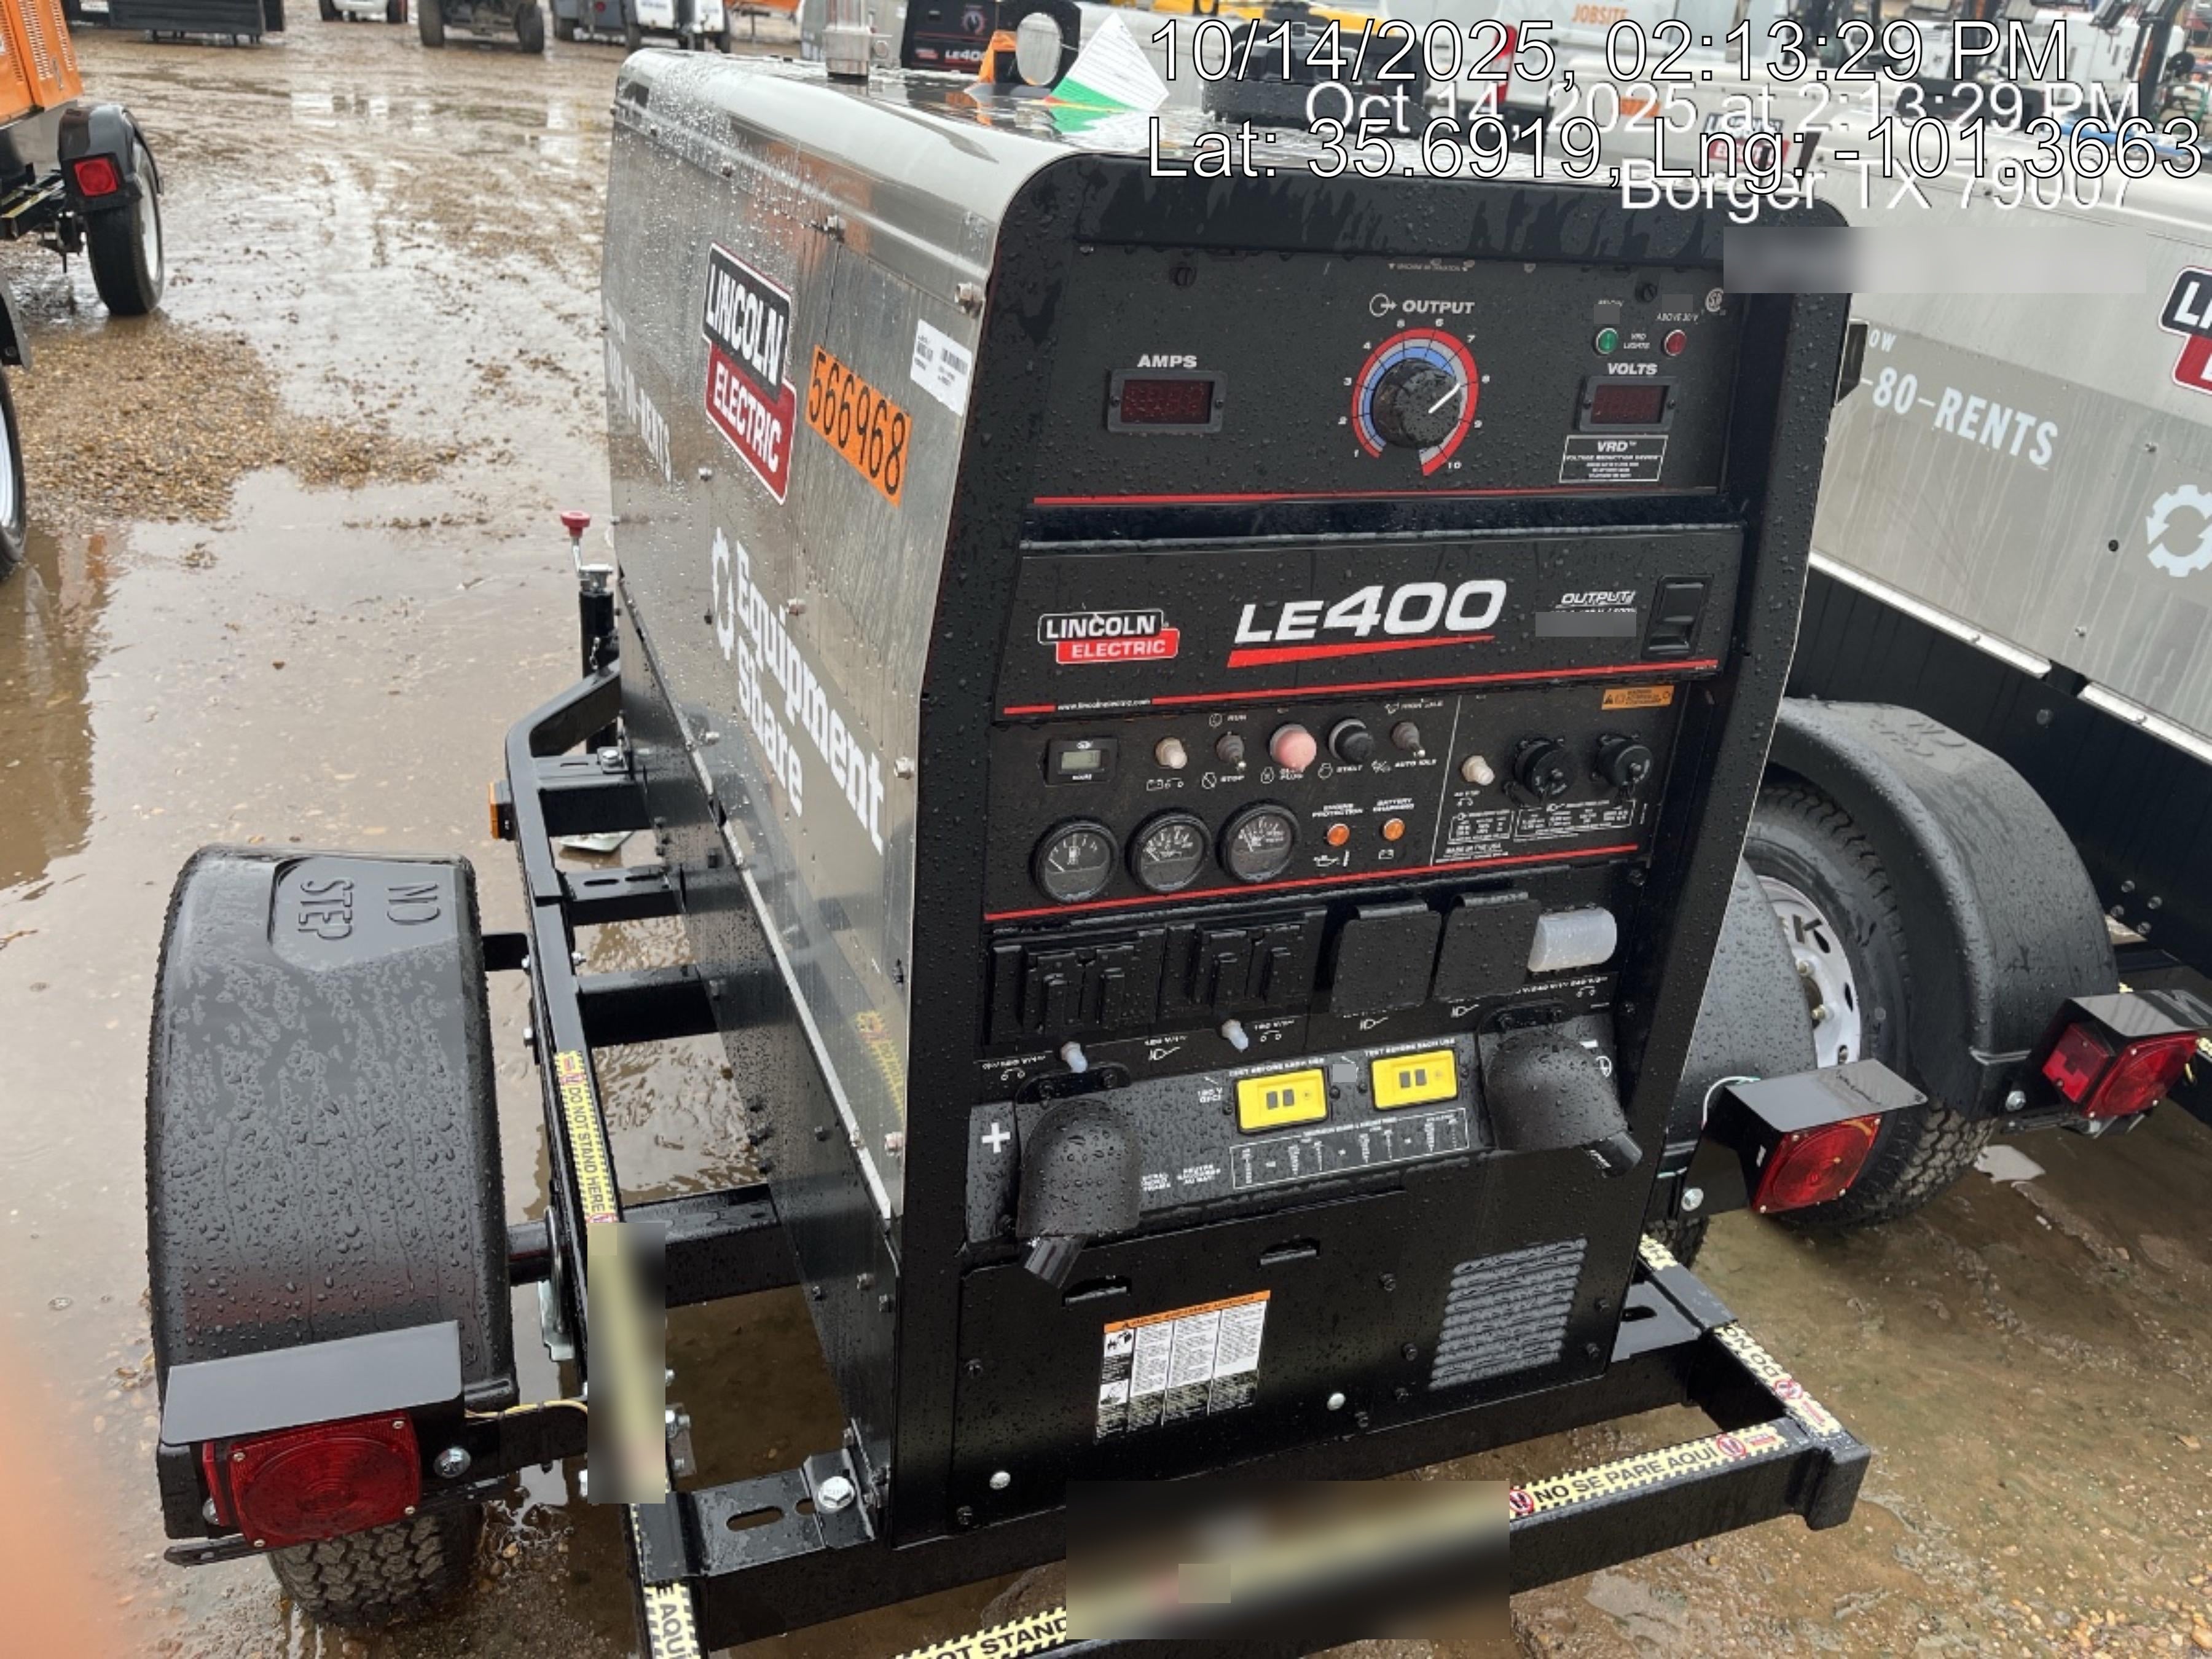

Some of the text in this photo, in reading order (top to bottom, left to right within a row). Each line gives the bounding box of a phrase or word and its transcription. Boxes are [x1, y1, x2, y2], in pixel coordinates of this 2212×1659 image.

[945, 49, 984, 61] LE40
[1402, 300, 1475, 314] OUTPUT
[706, 264, 783, 386] LINCOLN
[1435, 318, 1443, 327] 6
[1363, 342, 1372, 350] 4
[1467, 335, 1475, 343] 7
[1137, 353, 1198, 368] AMPS
[1607, 363, 1658, 375] VOLTS
[713, 360, 782, 474] ELECTRIC
[809, 353, 906, 495] 566968
[1234, 579, 1507, 643] LE400
[1046, 615, 1156, 638] LINCOLN
[1072, 640, 1166, 658] ELECTRIC
[737, 540, 884, 856] Equipment
[738, 636, 802, 817] Share
[297, 879, 355, 941] STEP
[387, 883, 441, 925] NO
[569, 1086, 582, 1104] DO
[573, 1106, 589, 1129] NOT
[578, 1133, 597, 1174] STAND
[586, 1176, 605, 1212] HERE
[1722, 1326, 1752, 1350] NO
[1534, 1484, 1570, 1504] NO
[1575, 1475, 1606, 1494] SE
[1606, 1459, 1665, 1485] PARE
